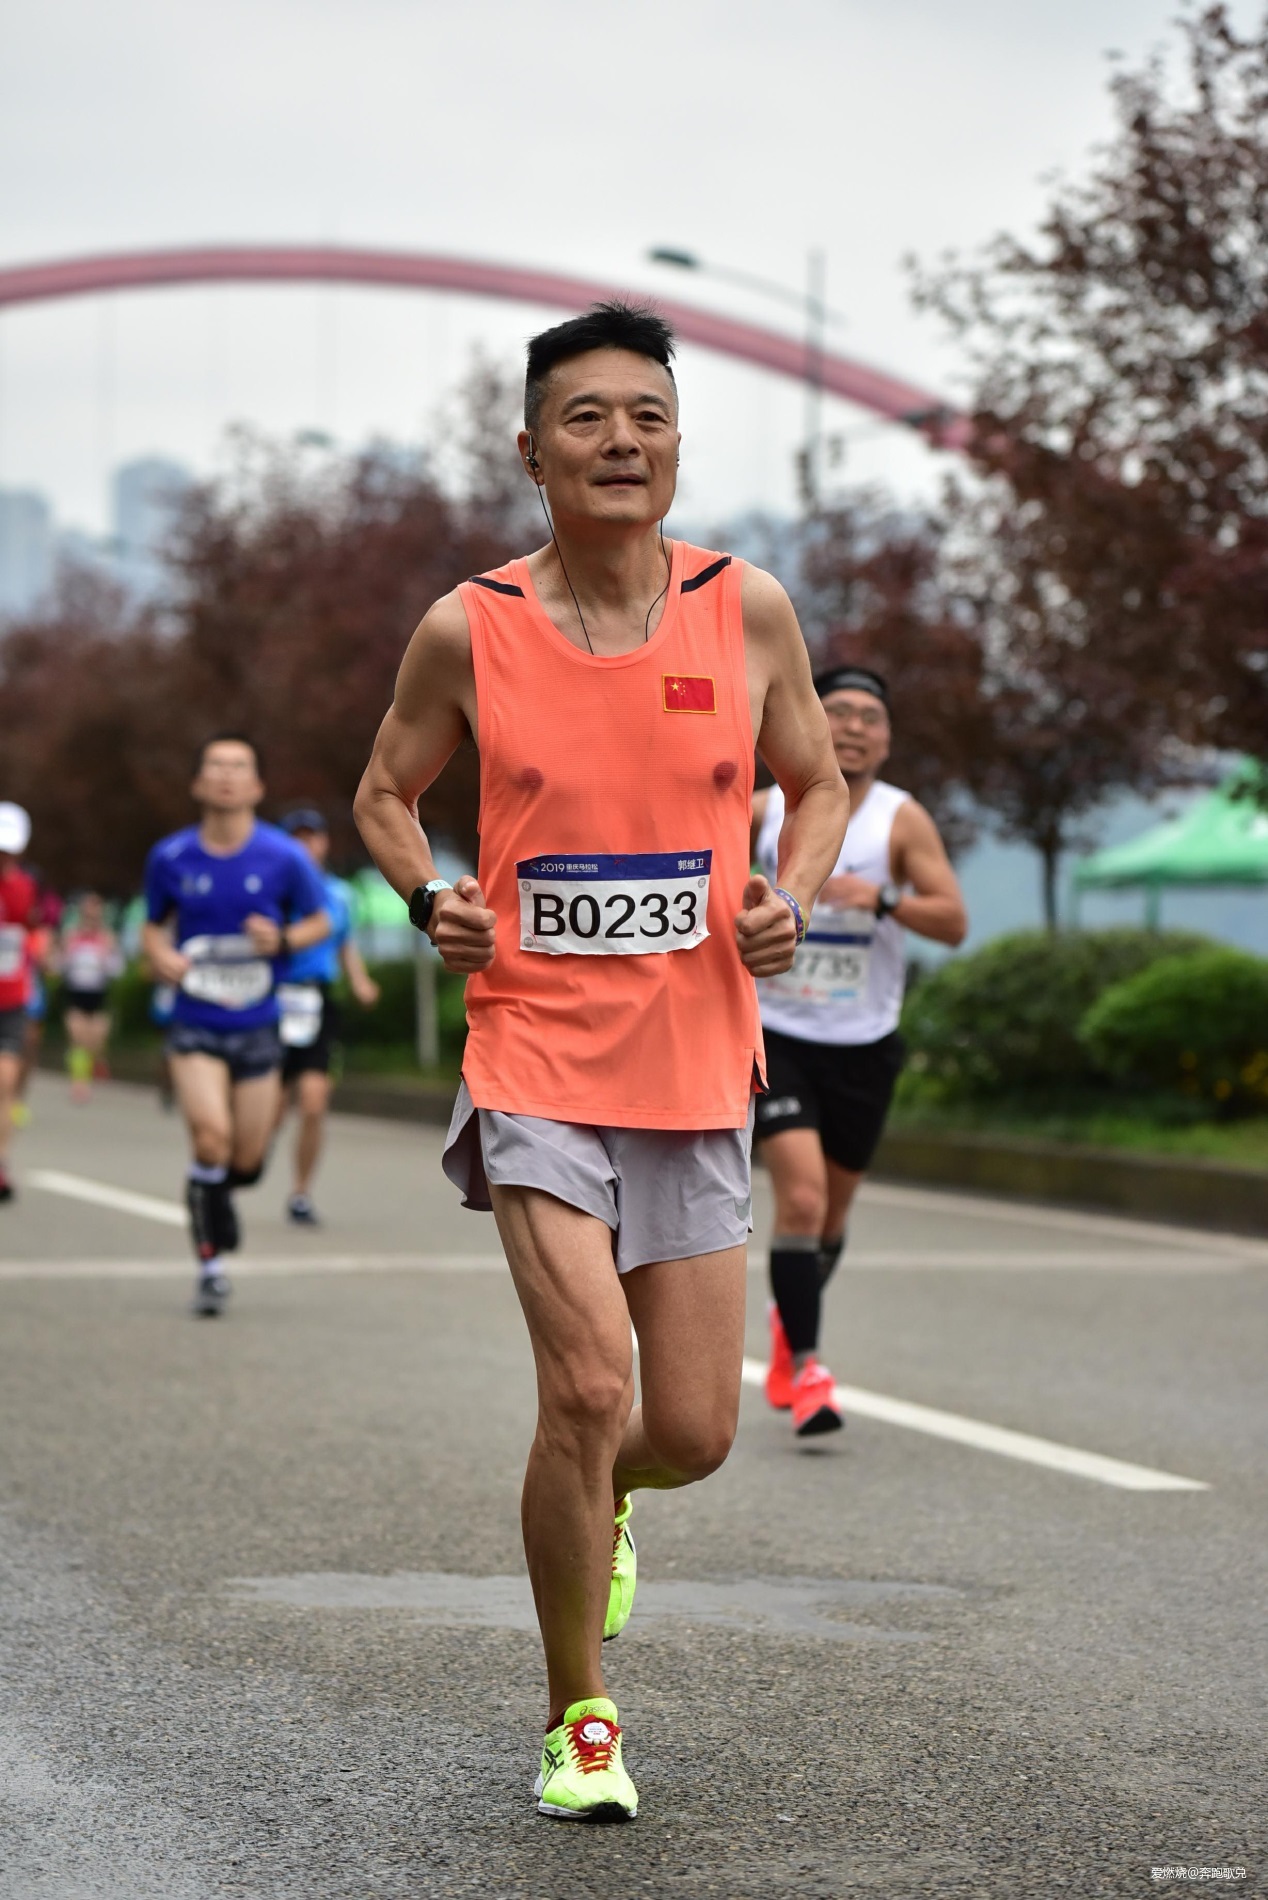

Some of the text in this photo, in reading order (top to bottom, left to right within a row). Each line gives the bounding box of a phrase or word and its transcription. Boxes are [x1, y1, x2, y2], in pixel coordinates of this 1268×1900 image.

[541, 863, 565, 873] 2019
[566, 863, 598, 871] 重庆马拉松
[677, 858, 704, 871] 郭继卫
[533, 890, 698, 939] B0233
